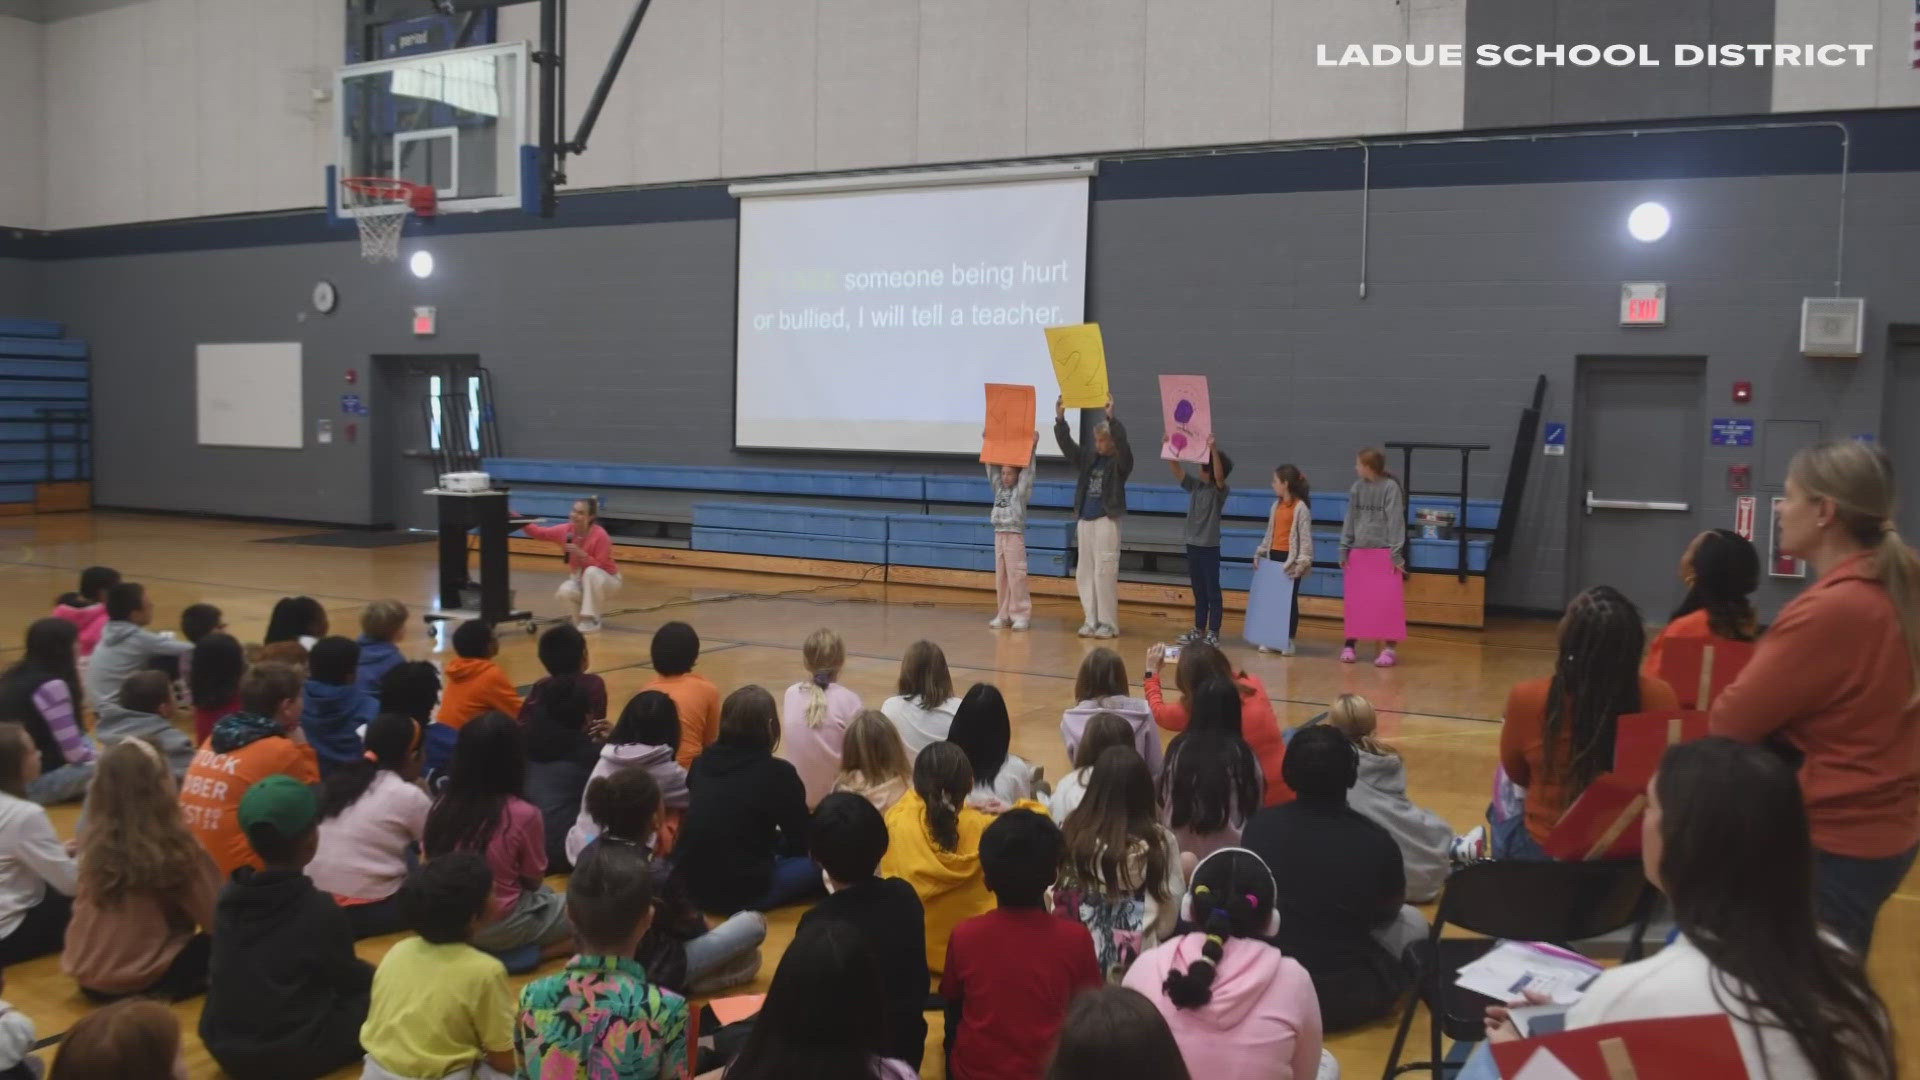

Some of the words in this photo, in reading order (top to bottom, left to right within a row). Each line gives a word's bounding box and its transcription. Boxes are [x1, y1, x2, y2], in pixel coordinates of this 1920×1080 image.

[844, 267, 945, 291] someone
[951, 261, 1014, 291] being
[1021, 259, 1068, 284] hurt
[752, 312, 775, 330] or
[778, 305, 850, 332] bullied,
[858, 305, 865, 328] I
[871, 304, 905, 328] will
[911, 302, 943, 327] tell
[950, 307, 963, 326] a
[971, 301, 1064, 326] teacher.
[1628, 298, 1659, 321] EXIT
